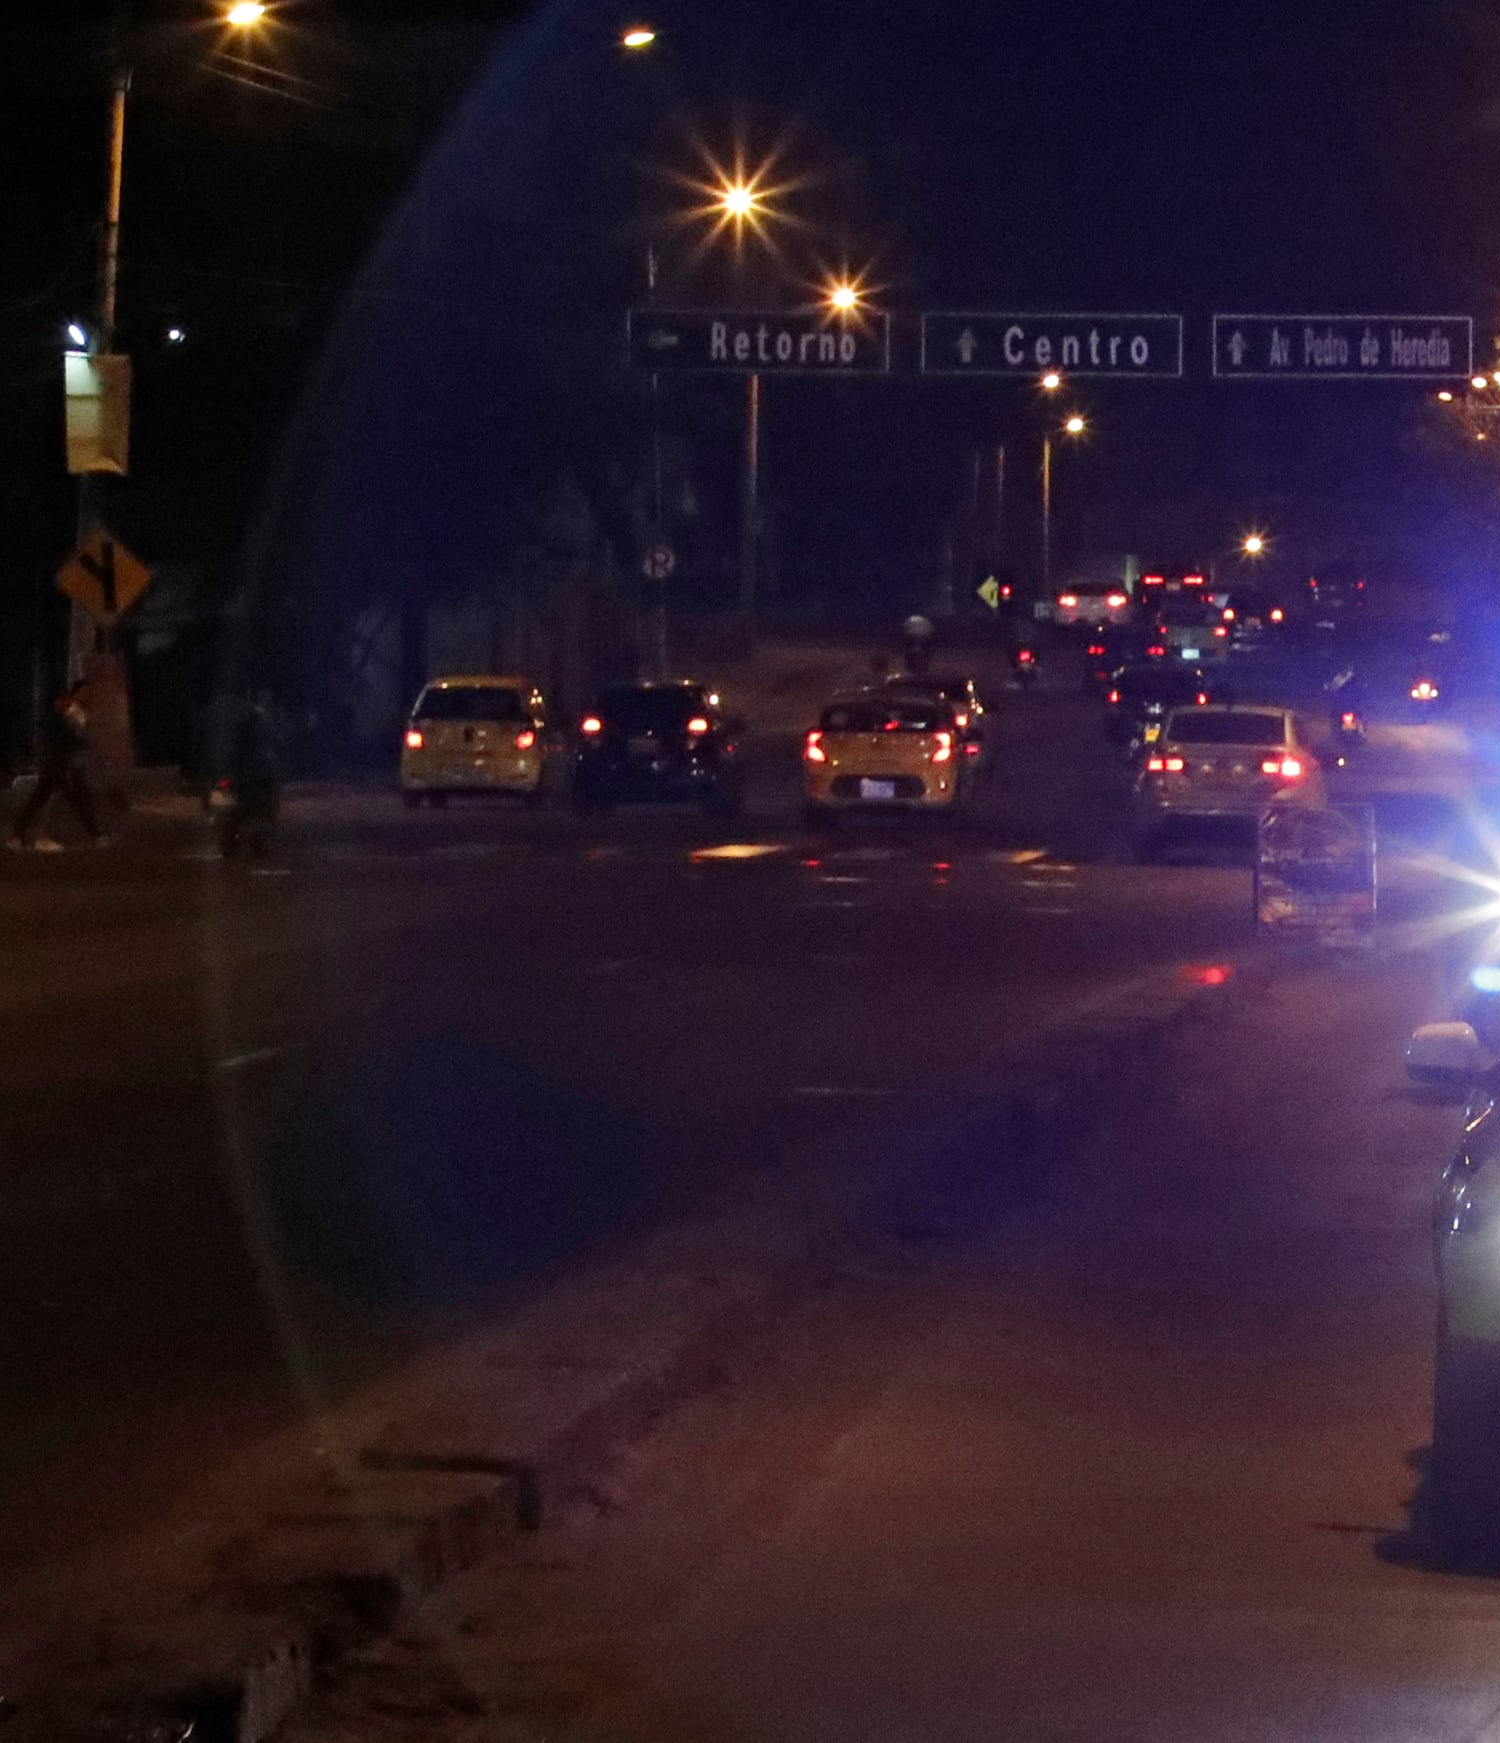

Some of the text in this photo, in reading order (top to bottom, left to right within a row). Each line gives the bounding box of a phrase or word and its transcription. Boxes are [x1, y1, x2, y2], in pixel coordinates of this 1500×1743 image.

[711, 321, 856, 362] Retorno
[1003, 325, 1149, 366] Centro
[1304, 327, 1348, 366] Pedro
[1360, 327, 1379, 366] de
[1391, 328, 1450, 367] Heredia
